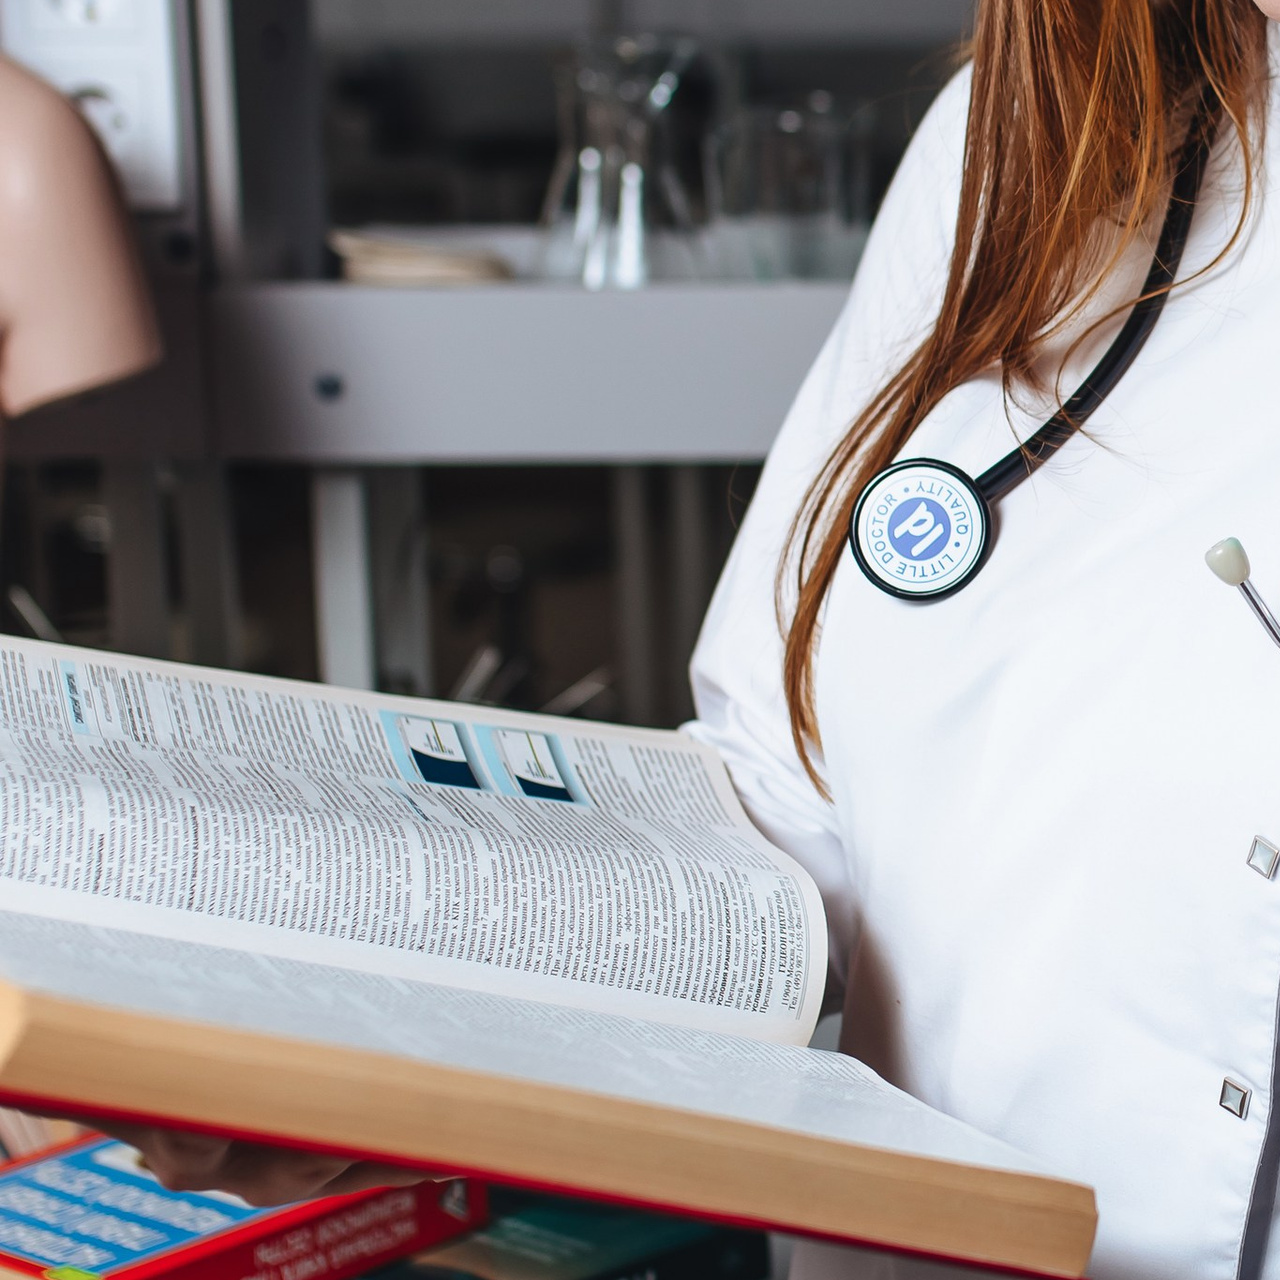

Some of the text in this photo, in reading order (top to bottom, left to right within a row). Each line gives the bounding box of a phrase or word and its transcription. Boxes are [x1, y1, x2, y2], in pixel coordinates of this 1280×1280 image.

[915, 480, 969, 535] QUALITY
[871, 493, 954, 578] LITTLE DOCTOR
[508, 915, 518, 950] времени
[539, 904, 548, 944] упаковки,
[574, 911, 585, 952] ферменты
[632, 910, 641, 937] другой
[776, 903, 785, 935] РИХТЕР
[483, 917, 499, 965] Женщины,
[514, 946, 523, 970] после
[523, 930, 536, 972] препарата
[542, 944, 554, 976] следует
[648, 934, 659, 975] диеногест
[706, 926, 715, 967] маточному
[617, 943, 629, 989] снижению
[638, 950, 647, 979] основе
[662, 963, 675, 997] поэтому
[671, 975, 681, 999] ствия
[677, 947, 685, 975] такого
[694, 948, 703, 983] половых
[716, 971, 728, 1007] УСЛОВИЯ
[723, 934, 731, 971] ХРАНЕНИЯ
[723, 970, 739, 1008] Препарат
[733, 938, 742, 967] следует
[743, 993, 753, 1012] туре
[750, 919, 759, 937] Срок
[751, 978, 763, 1013] УСЛОВИЯ
[758, 945, 766, 978] ОТПУСКА
[784, 946, 796, 979] Москва,
[793, 970, 801, 990] (495)
[732, 984, 746, 1011] детей,
[758, 976, 774, 1015] Препарат
[780, 979, 792, 1007] 119049
